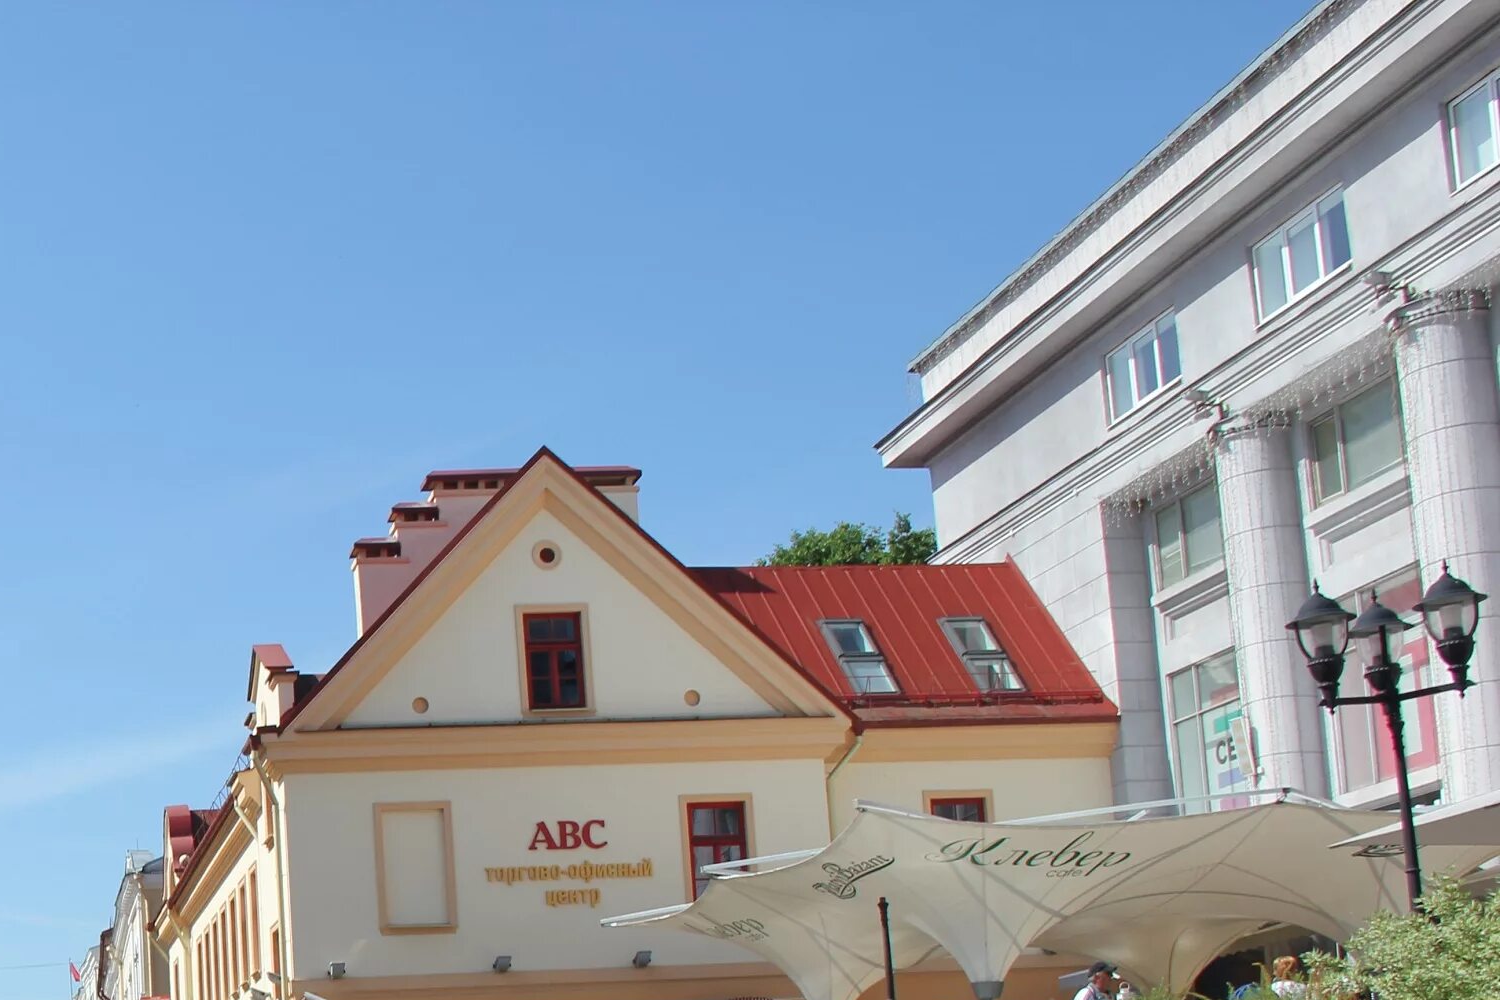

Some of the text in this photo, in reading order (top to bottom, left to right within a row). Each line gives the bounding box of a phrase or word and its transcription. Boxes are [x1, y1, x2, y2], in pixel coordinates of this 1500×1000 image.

[924, 831, 1131, 876] Клевер
[484, 858, 653, 886] торгово-офисный
[545, 887, 601, 908] центр
